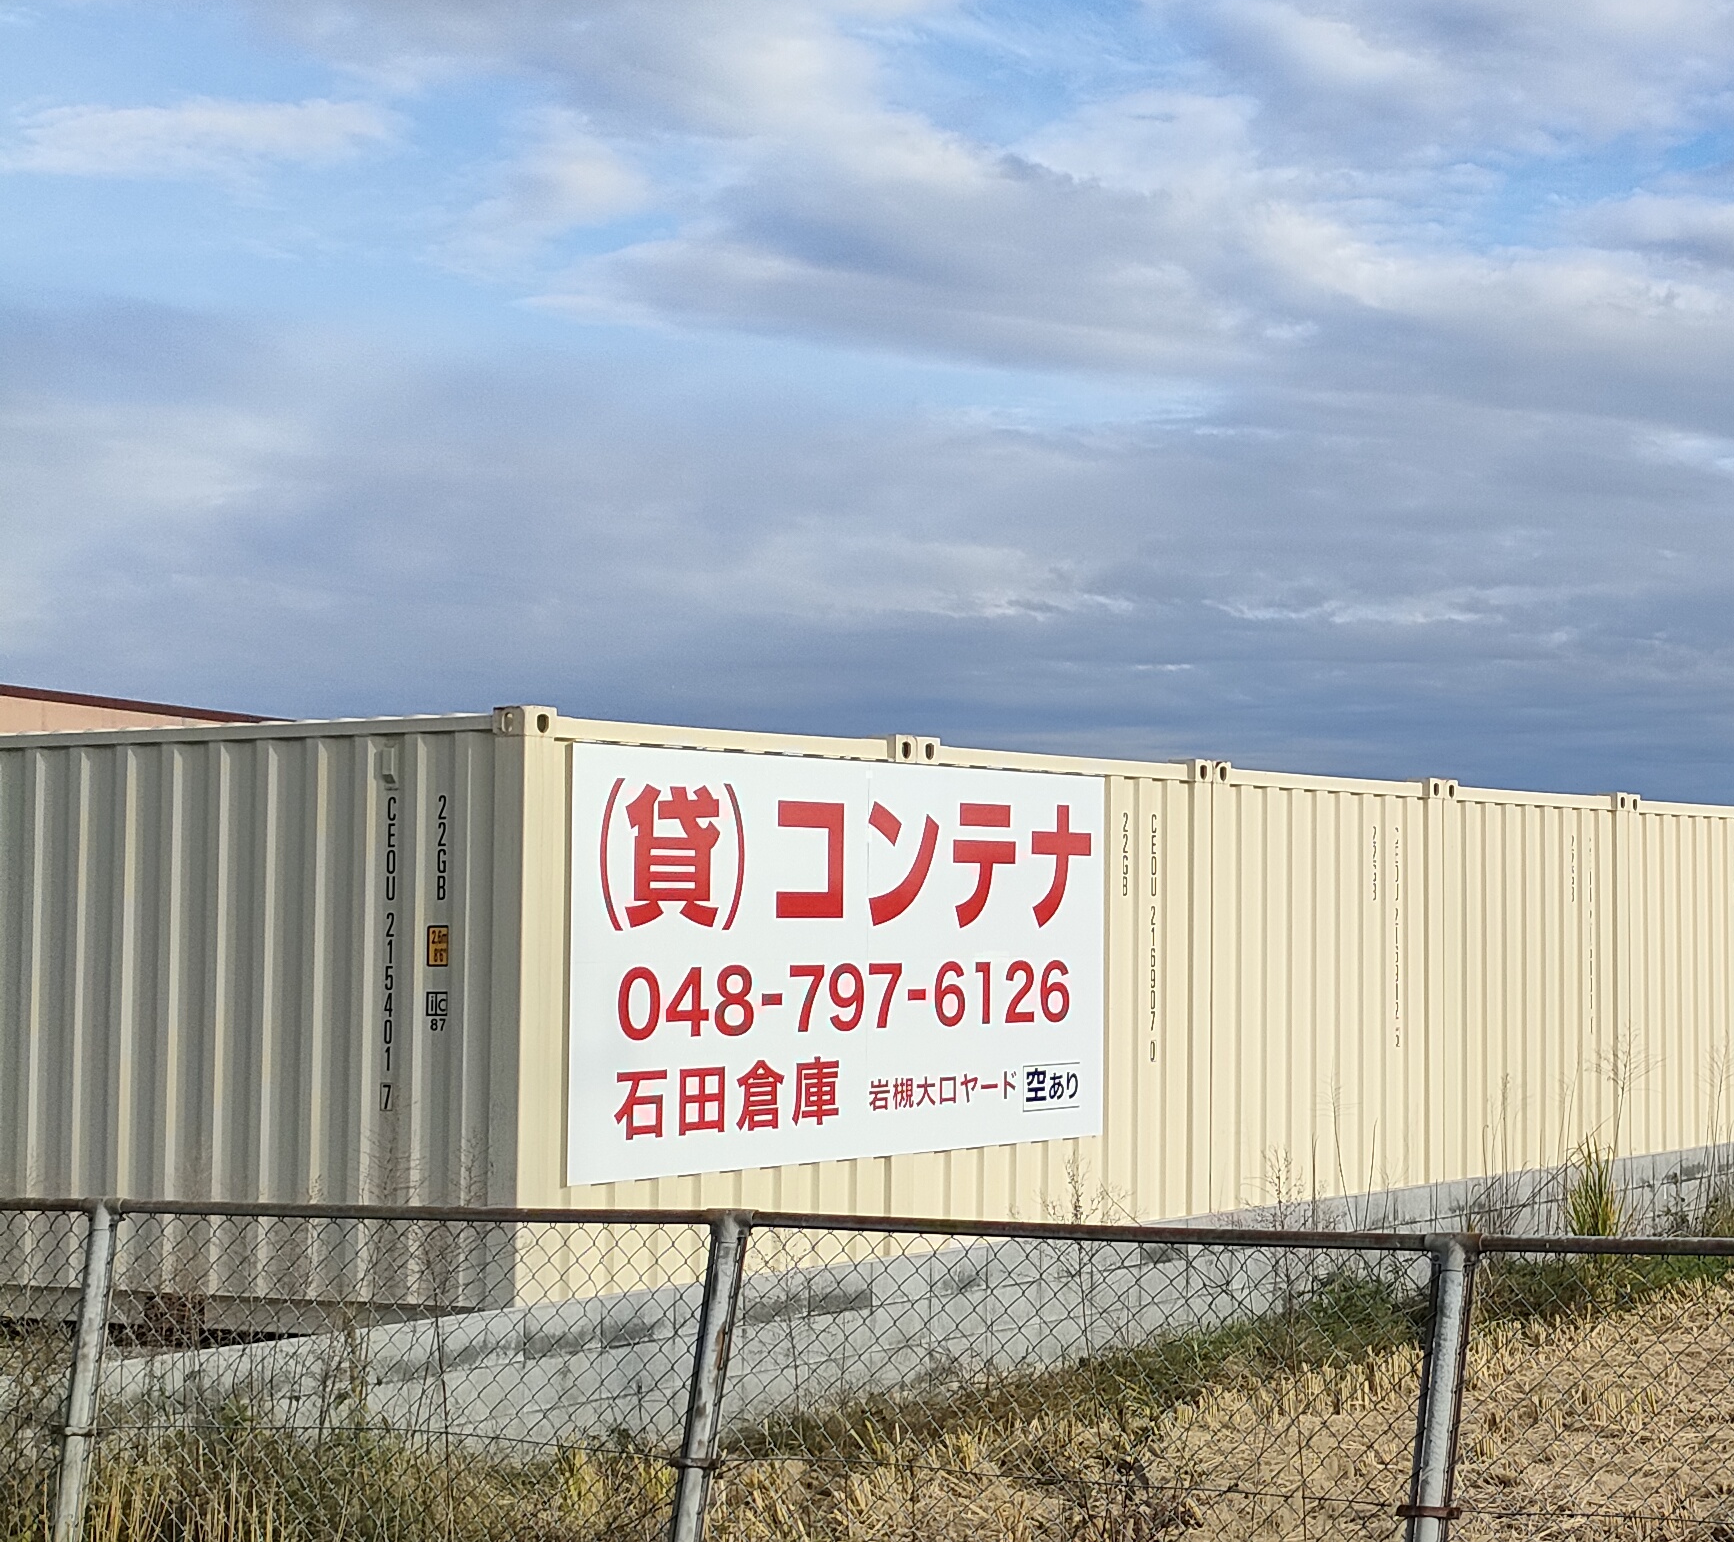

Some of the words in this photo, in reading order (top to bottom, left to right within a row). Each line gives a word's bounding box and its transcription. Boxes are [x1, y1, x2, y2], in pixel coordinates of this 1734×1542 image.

[385, 796, 397, 901] CEOU
[436, 794, 447, 901] 22GB
[383, 912, 396, 1072] 215401
[430, 1018, 446, 1032] 87
[618, 960, 1070, 1041] 048-797-6126
[381, 1084, 392, 1110] 7
[614, 1056, 839, 1140] 石田倉庫
[868, 1070, 1017, 1112] 岩槻大口ヤード
[1025, 1067, 1079, 1103] 空あり
